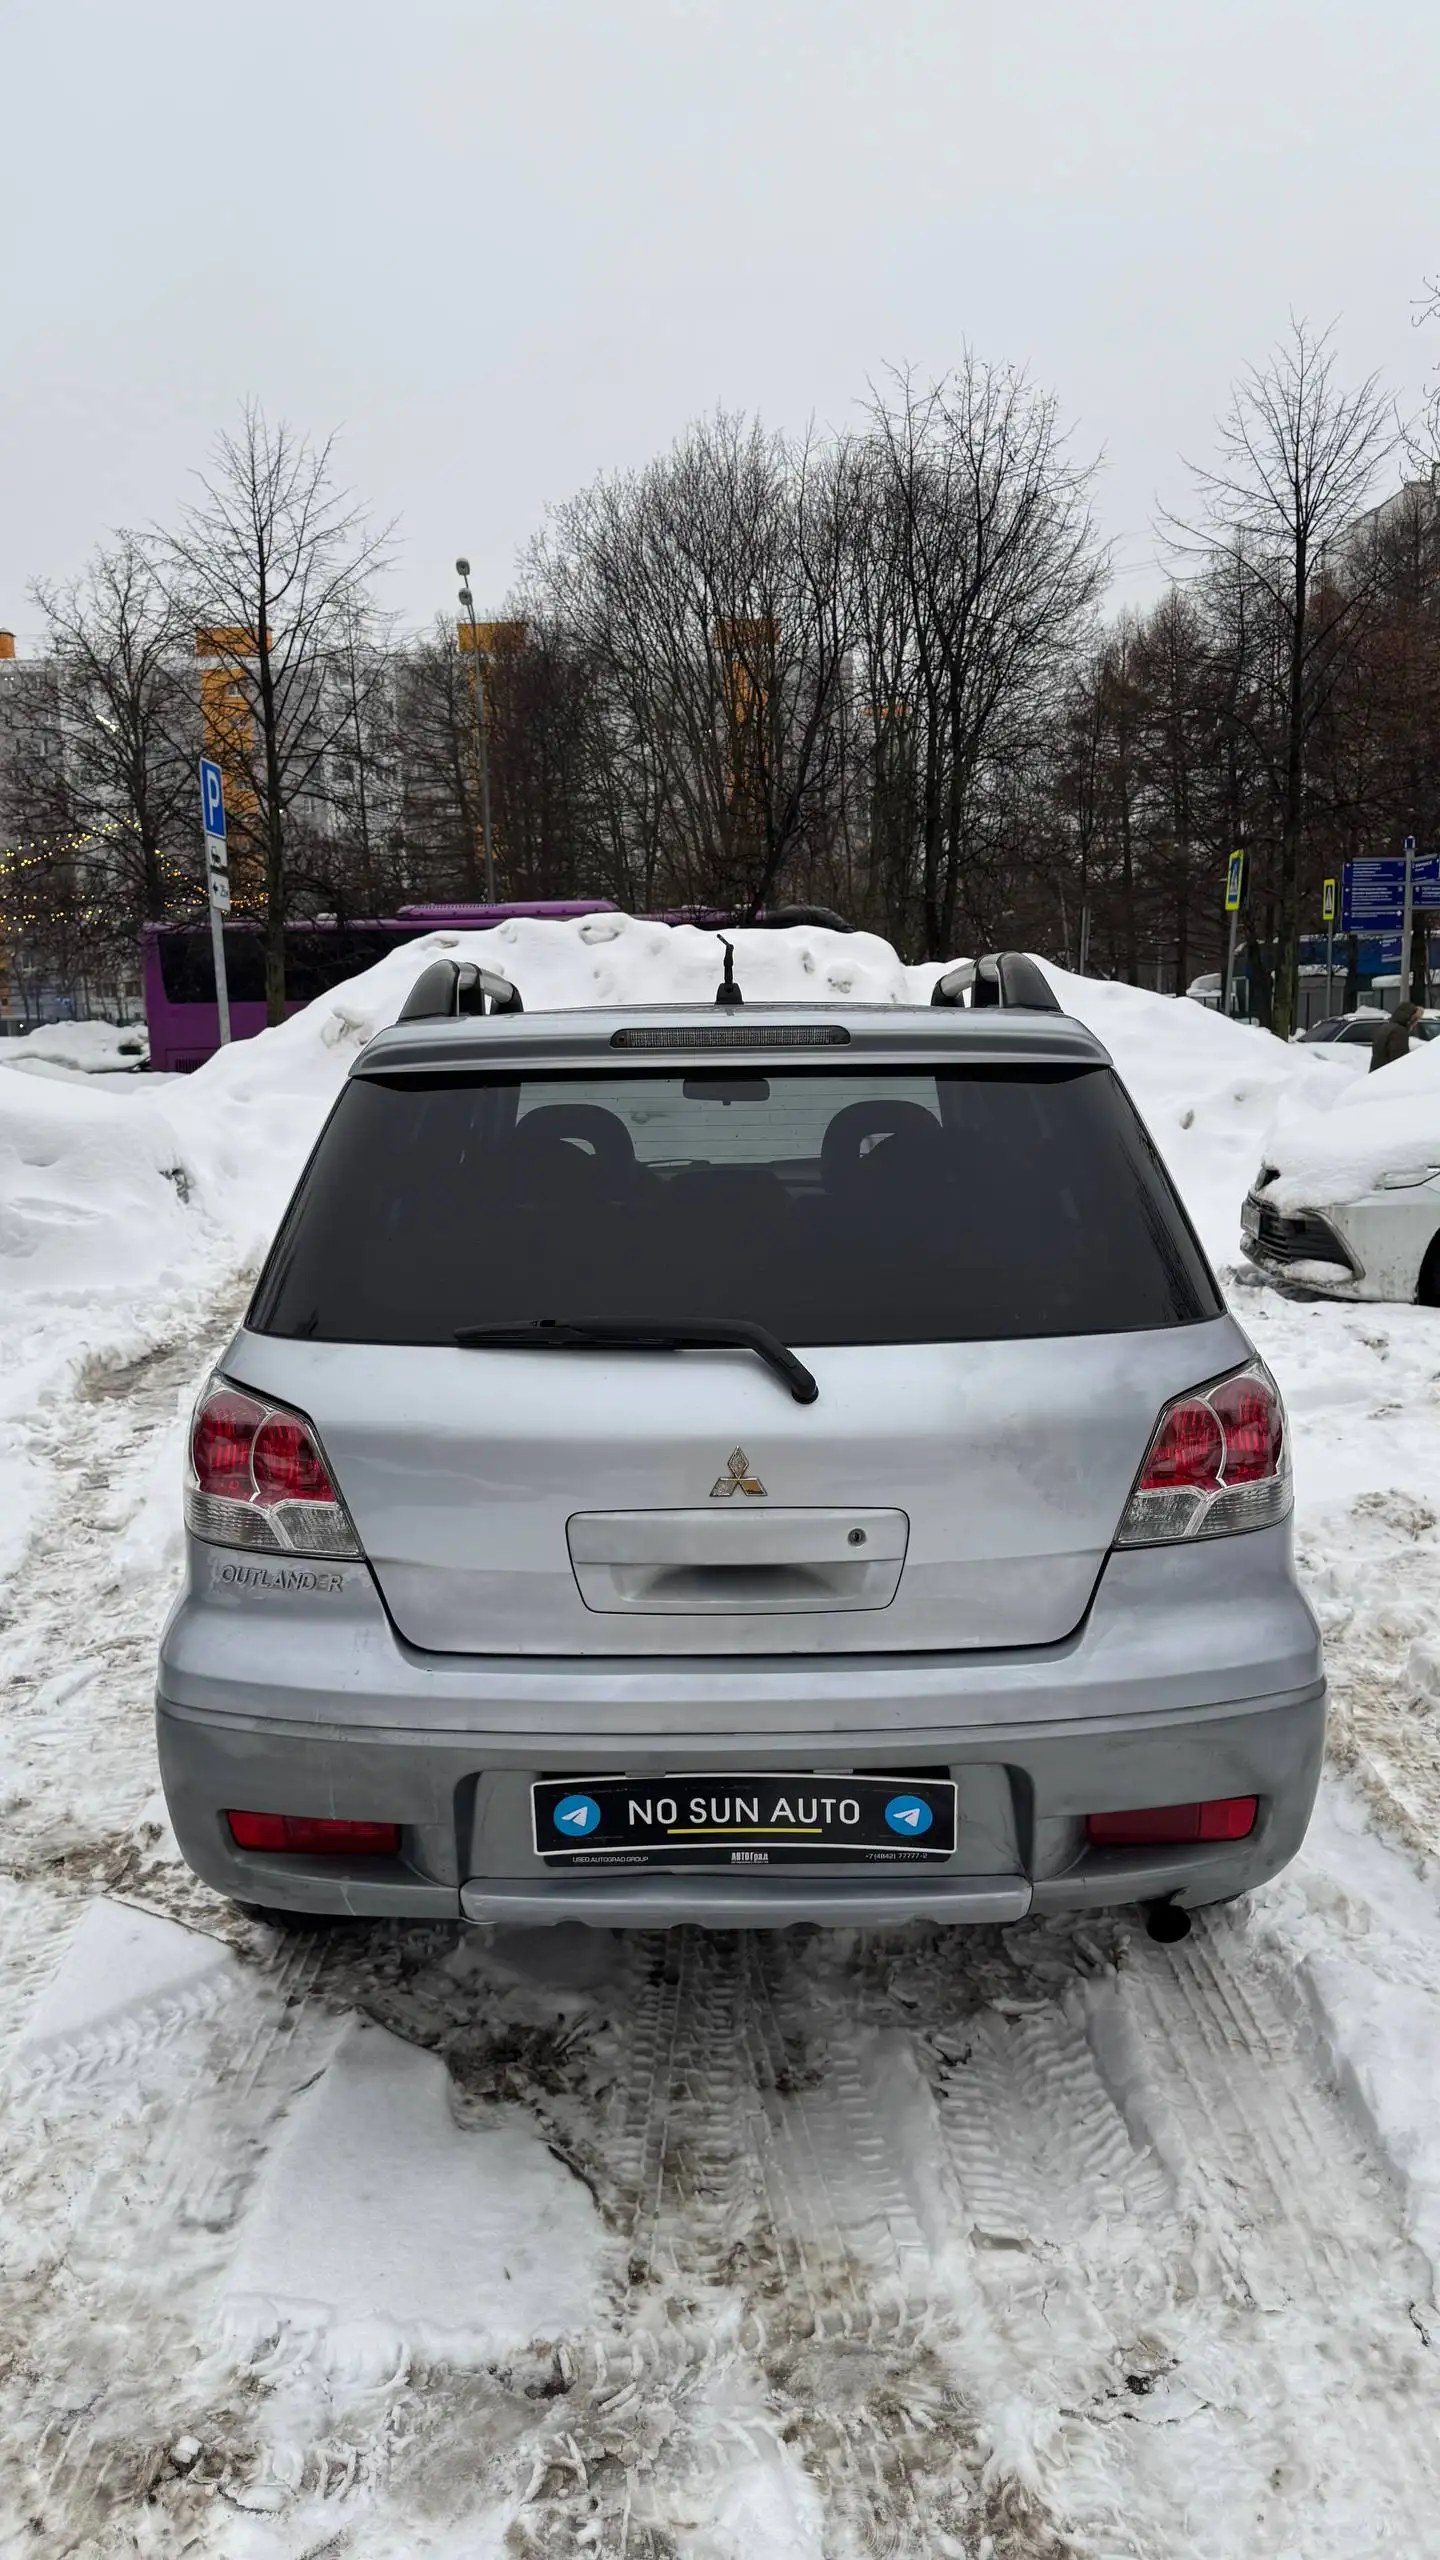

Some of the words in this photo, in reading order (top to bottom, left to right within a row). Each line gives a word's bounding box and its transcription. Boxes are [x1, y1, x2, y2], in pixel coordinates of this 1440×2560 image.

[206, 769, 220, 826] P
[629, 1798, 678, 1826] NO
[690, 1797, 759, 1824] SUN
[769, 1797, 861, 1825] AUTO
